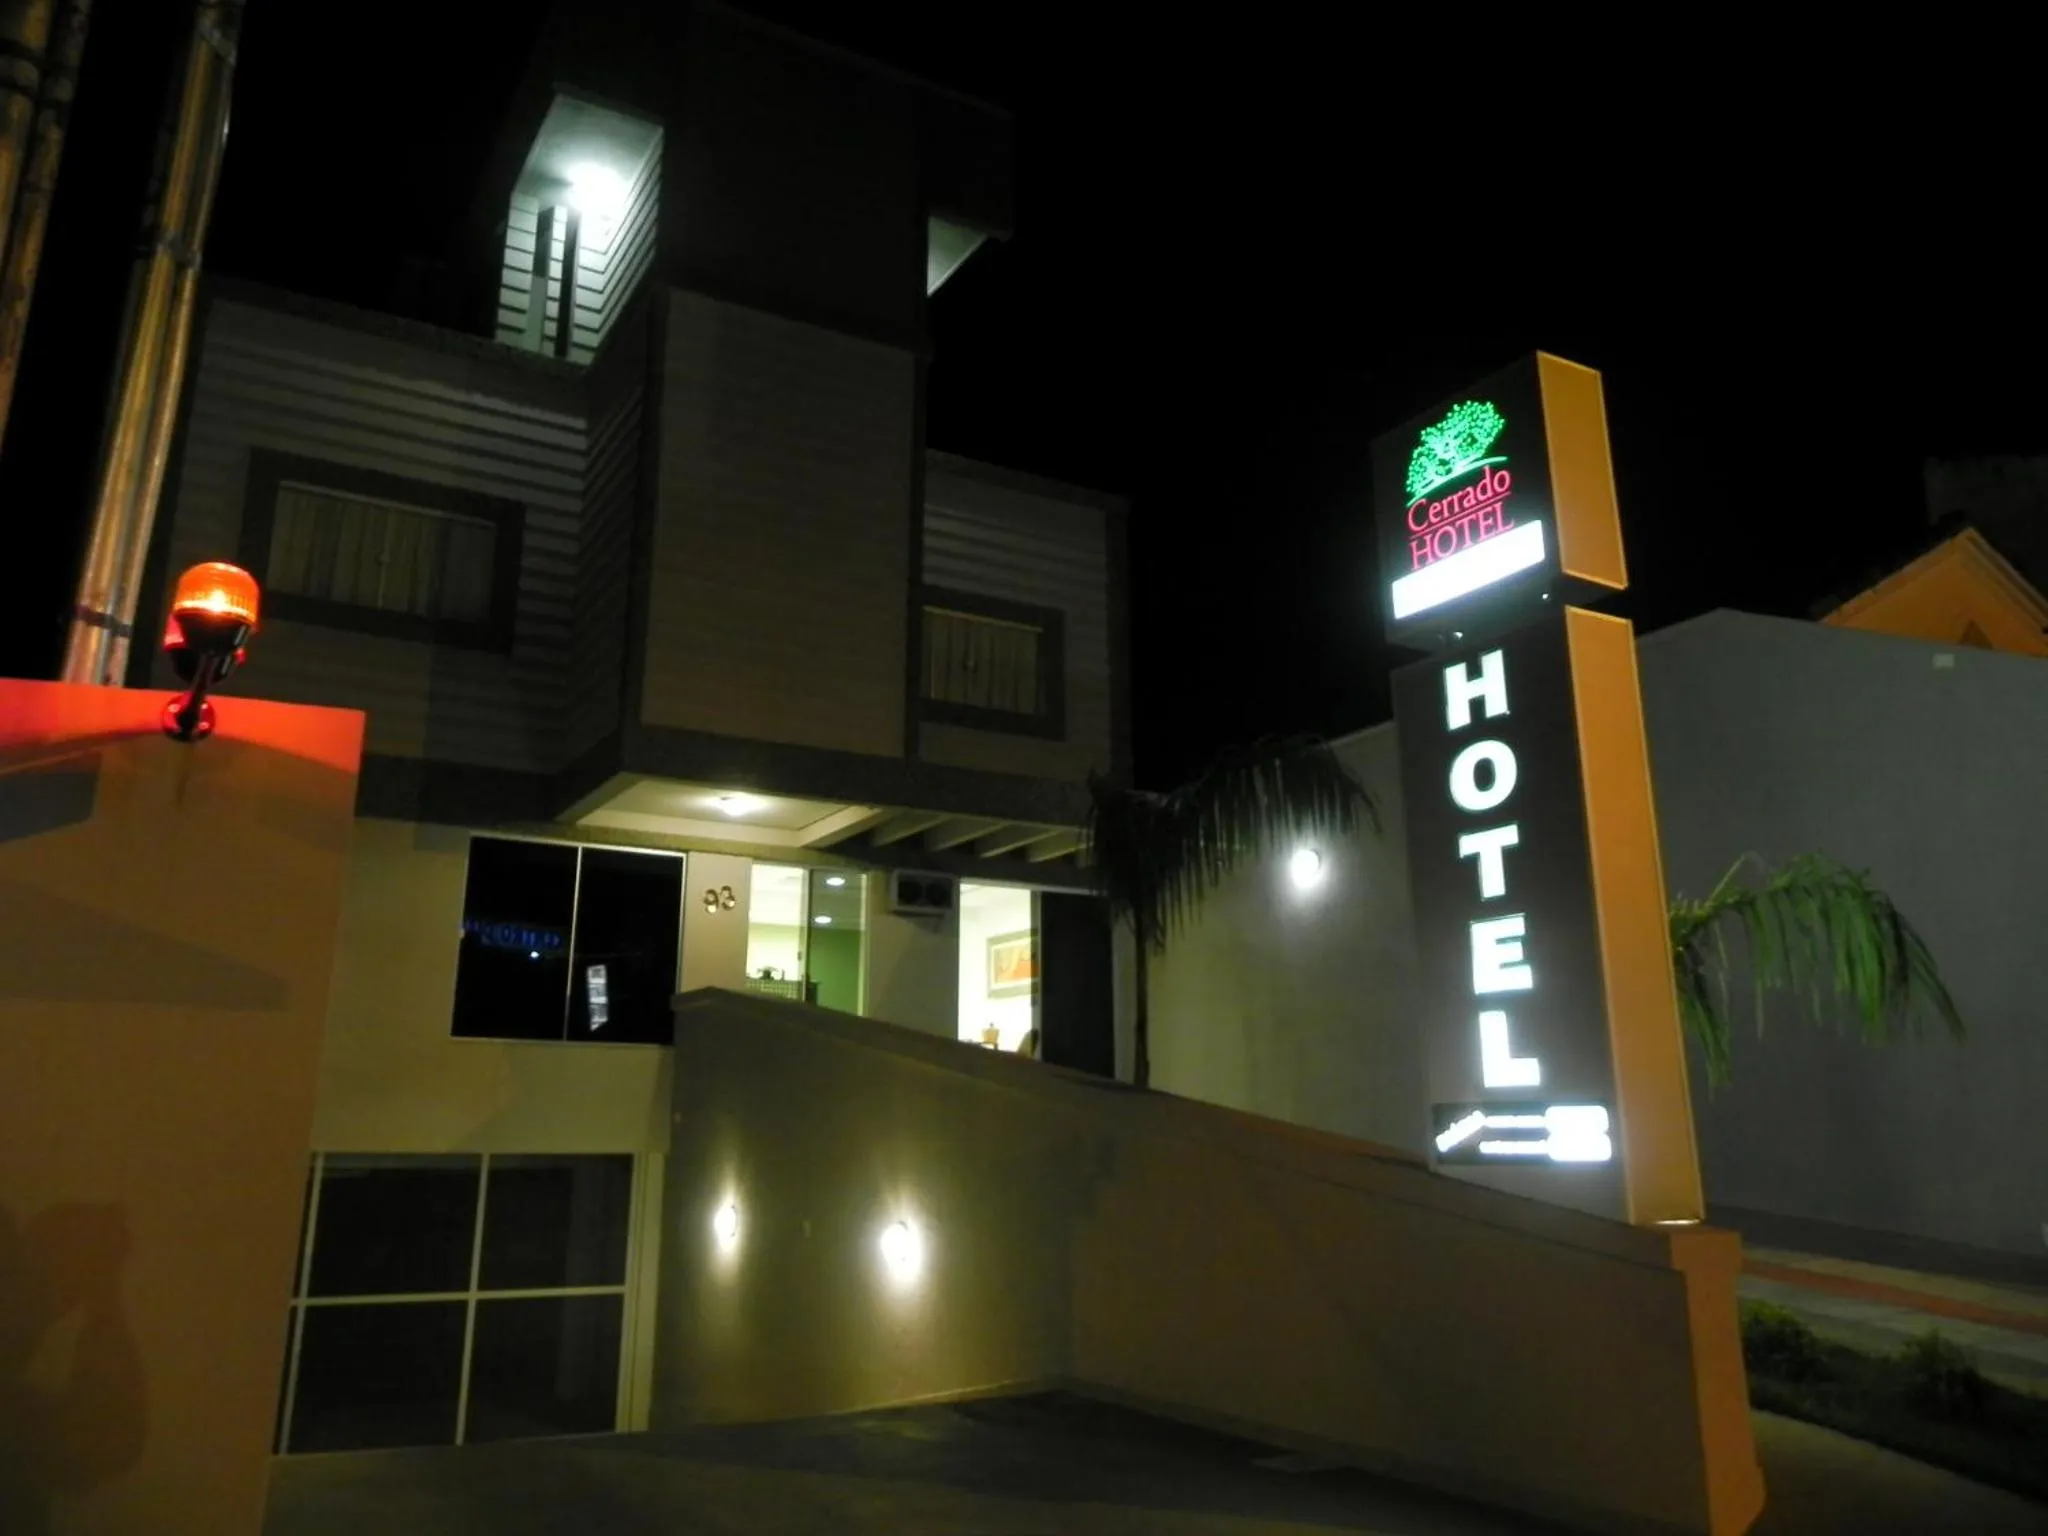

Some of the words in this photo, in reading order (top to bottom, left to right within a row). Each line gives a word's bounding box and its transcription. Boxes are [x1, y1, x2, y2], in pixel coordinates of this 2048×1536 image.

[1408, 465, 1511, 532] Cerrado
[1410, 502, 1515, 570] HOTEL
[703, 885, 735, 914] 93
[1443, 648, 1541, 1088] HOTEL
